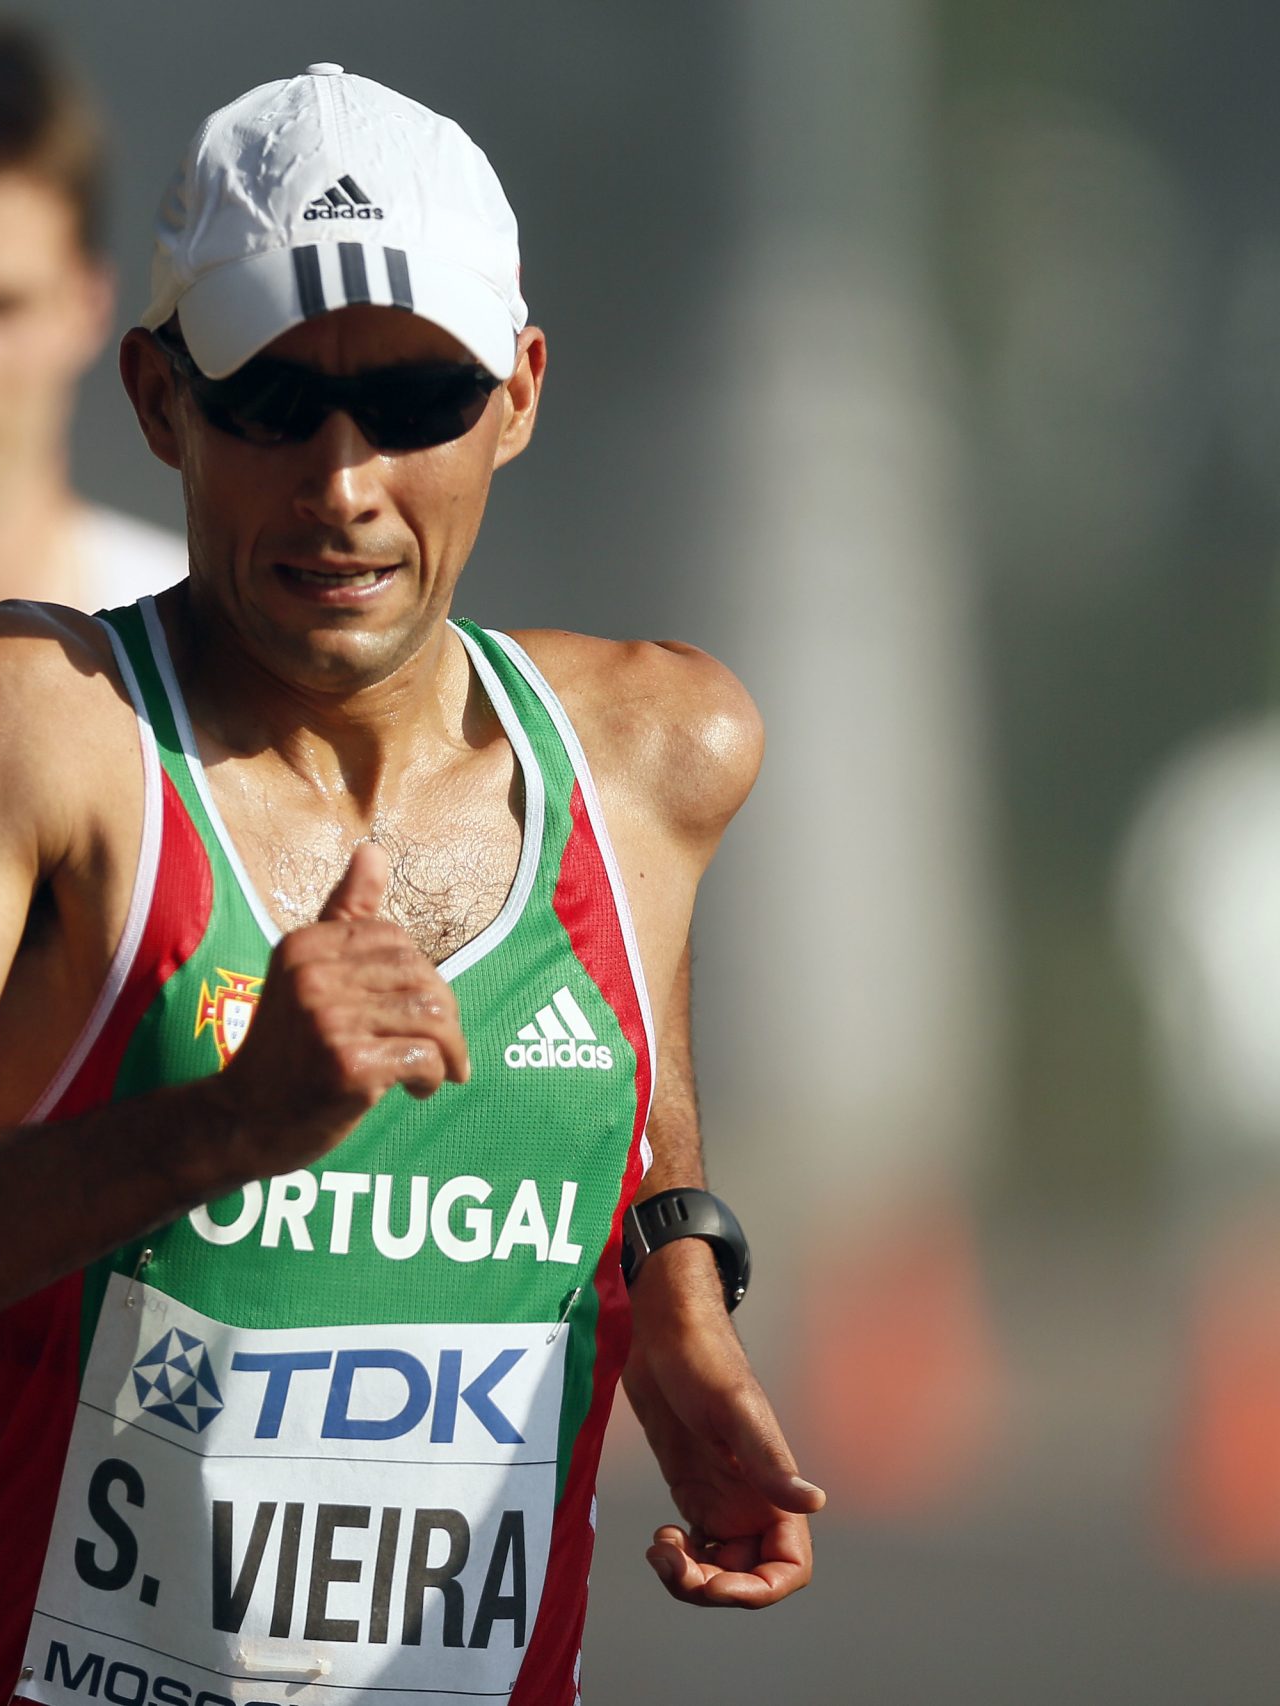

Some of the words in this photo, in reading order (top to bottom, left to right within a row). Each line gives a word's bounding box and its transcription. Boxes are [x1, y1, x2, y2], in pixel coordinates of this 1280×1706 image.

[303, 202, 384, 220] adidas
[504, 1038, 613, 1070] adidas
[189, 1168, 583, 1265] ORTUGAL
[230, 1348, 528, 1444] TDK
[74, 1458, 160, 1607] S.
[211, 1500, 528, 1649] VIEIRA
